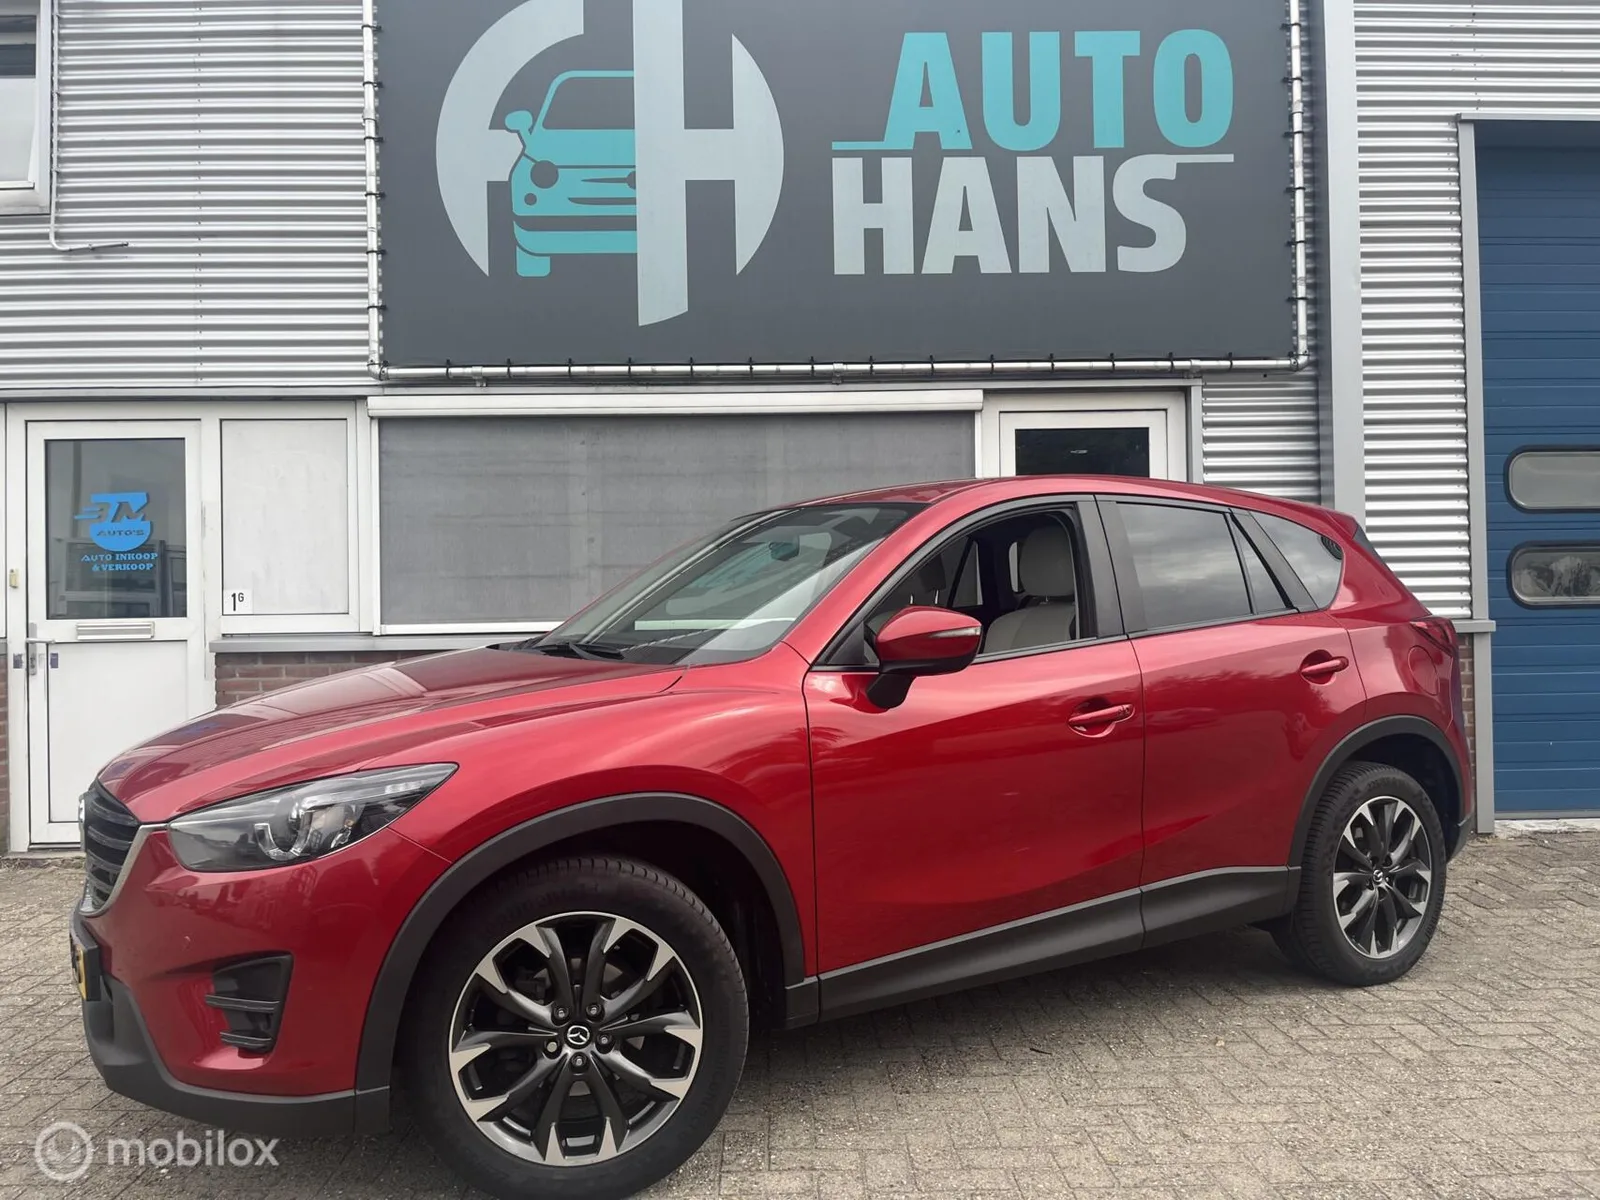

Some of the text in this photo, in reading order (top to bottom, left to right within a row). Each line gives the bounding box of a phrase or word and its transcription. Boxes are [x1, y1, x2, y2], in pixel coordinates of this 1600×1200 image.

[832, 29, 1234, 151] AUTO
[832, 154, 1234, 275] HANS
[81, 552, 158, 562] AUTO INKOOP
[97, 529, 145, 537] AUTO'S
